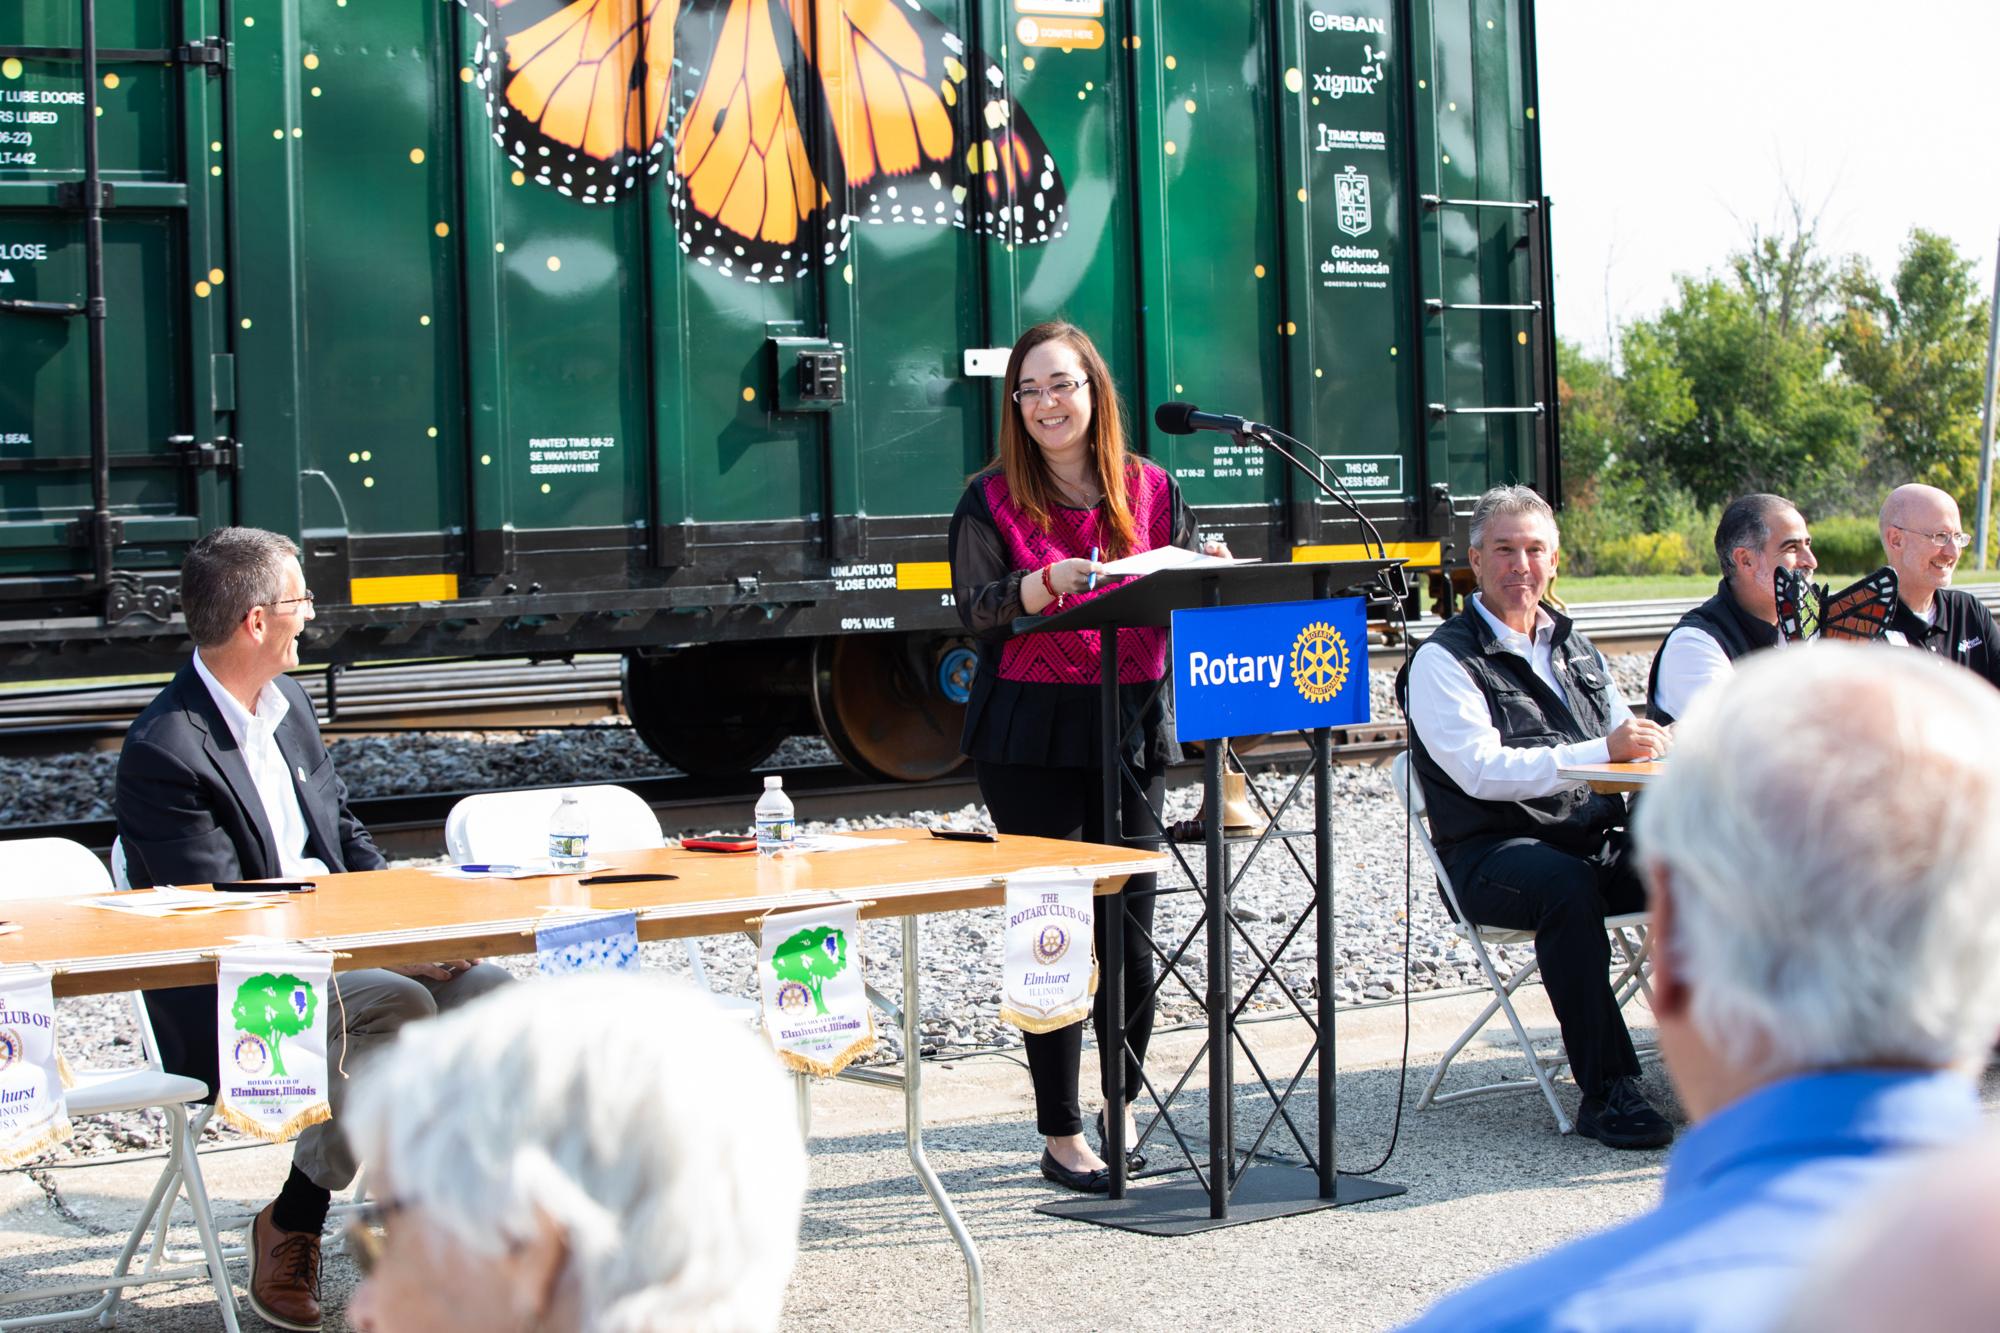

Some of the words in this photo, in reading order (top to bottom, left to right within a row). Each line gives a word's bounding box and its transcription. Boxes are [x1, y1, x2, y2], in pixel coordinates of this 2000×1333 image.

[1309, 11, 1385, 33] ORSAN
[1312, 66, 1375, 99] xignux
[6, 90, 40, 103] LUBE
[41, 91, 85, 104] DOORS
[0, 111, 14, 123] RS
[16, 112, 58, 124] LUBED
[0, 244, 48, 260] LOSE
[1331, 245, 1380, 260] Gobierno
[1320, 261, 1335, 274] de
[1336, 261, 1390, 275] Michoacán
[529, 438, 568, 449] PAINTED
[1345, 463, 1362, 474] THIS
[1362, 462, 1379, 474] CAR
[1363, 475, 1390, 487] HEIGHT
[1206, 532, 1225, 542] JACK
[831, 564, 878, 577] UNLATCH
[879, 563, 894, 575] TO
[867, 577, 897, 590] DOOR
[841, 617, 862, 630] 60%
[863, 617, 895, 629] VALVE
[1190, 651, 1284, 688] Rotary
[1040, 893, 1059, 904] THE
[1010, 904, 1049, 928] ROTARY
[1049, 904, 1077, 919] CLUB
[1023, 971, 1071, 986] Elmhurst
[1029, 987, 1065, 998] ILLINOIS
[1, 1086, 35, 1104] hurst
[0, 1103, 30, 1117] INOIS
[0, 1119, 18, 1129] SA
